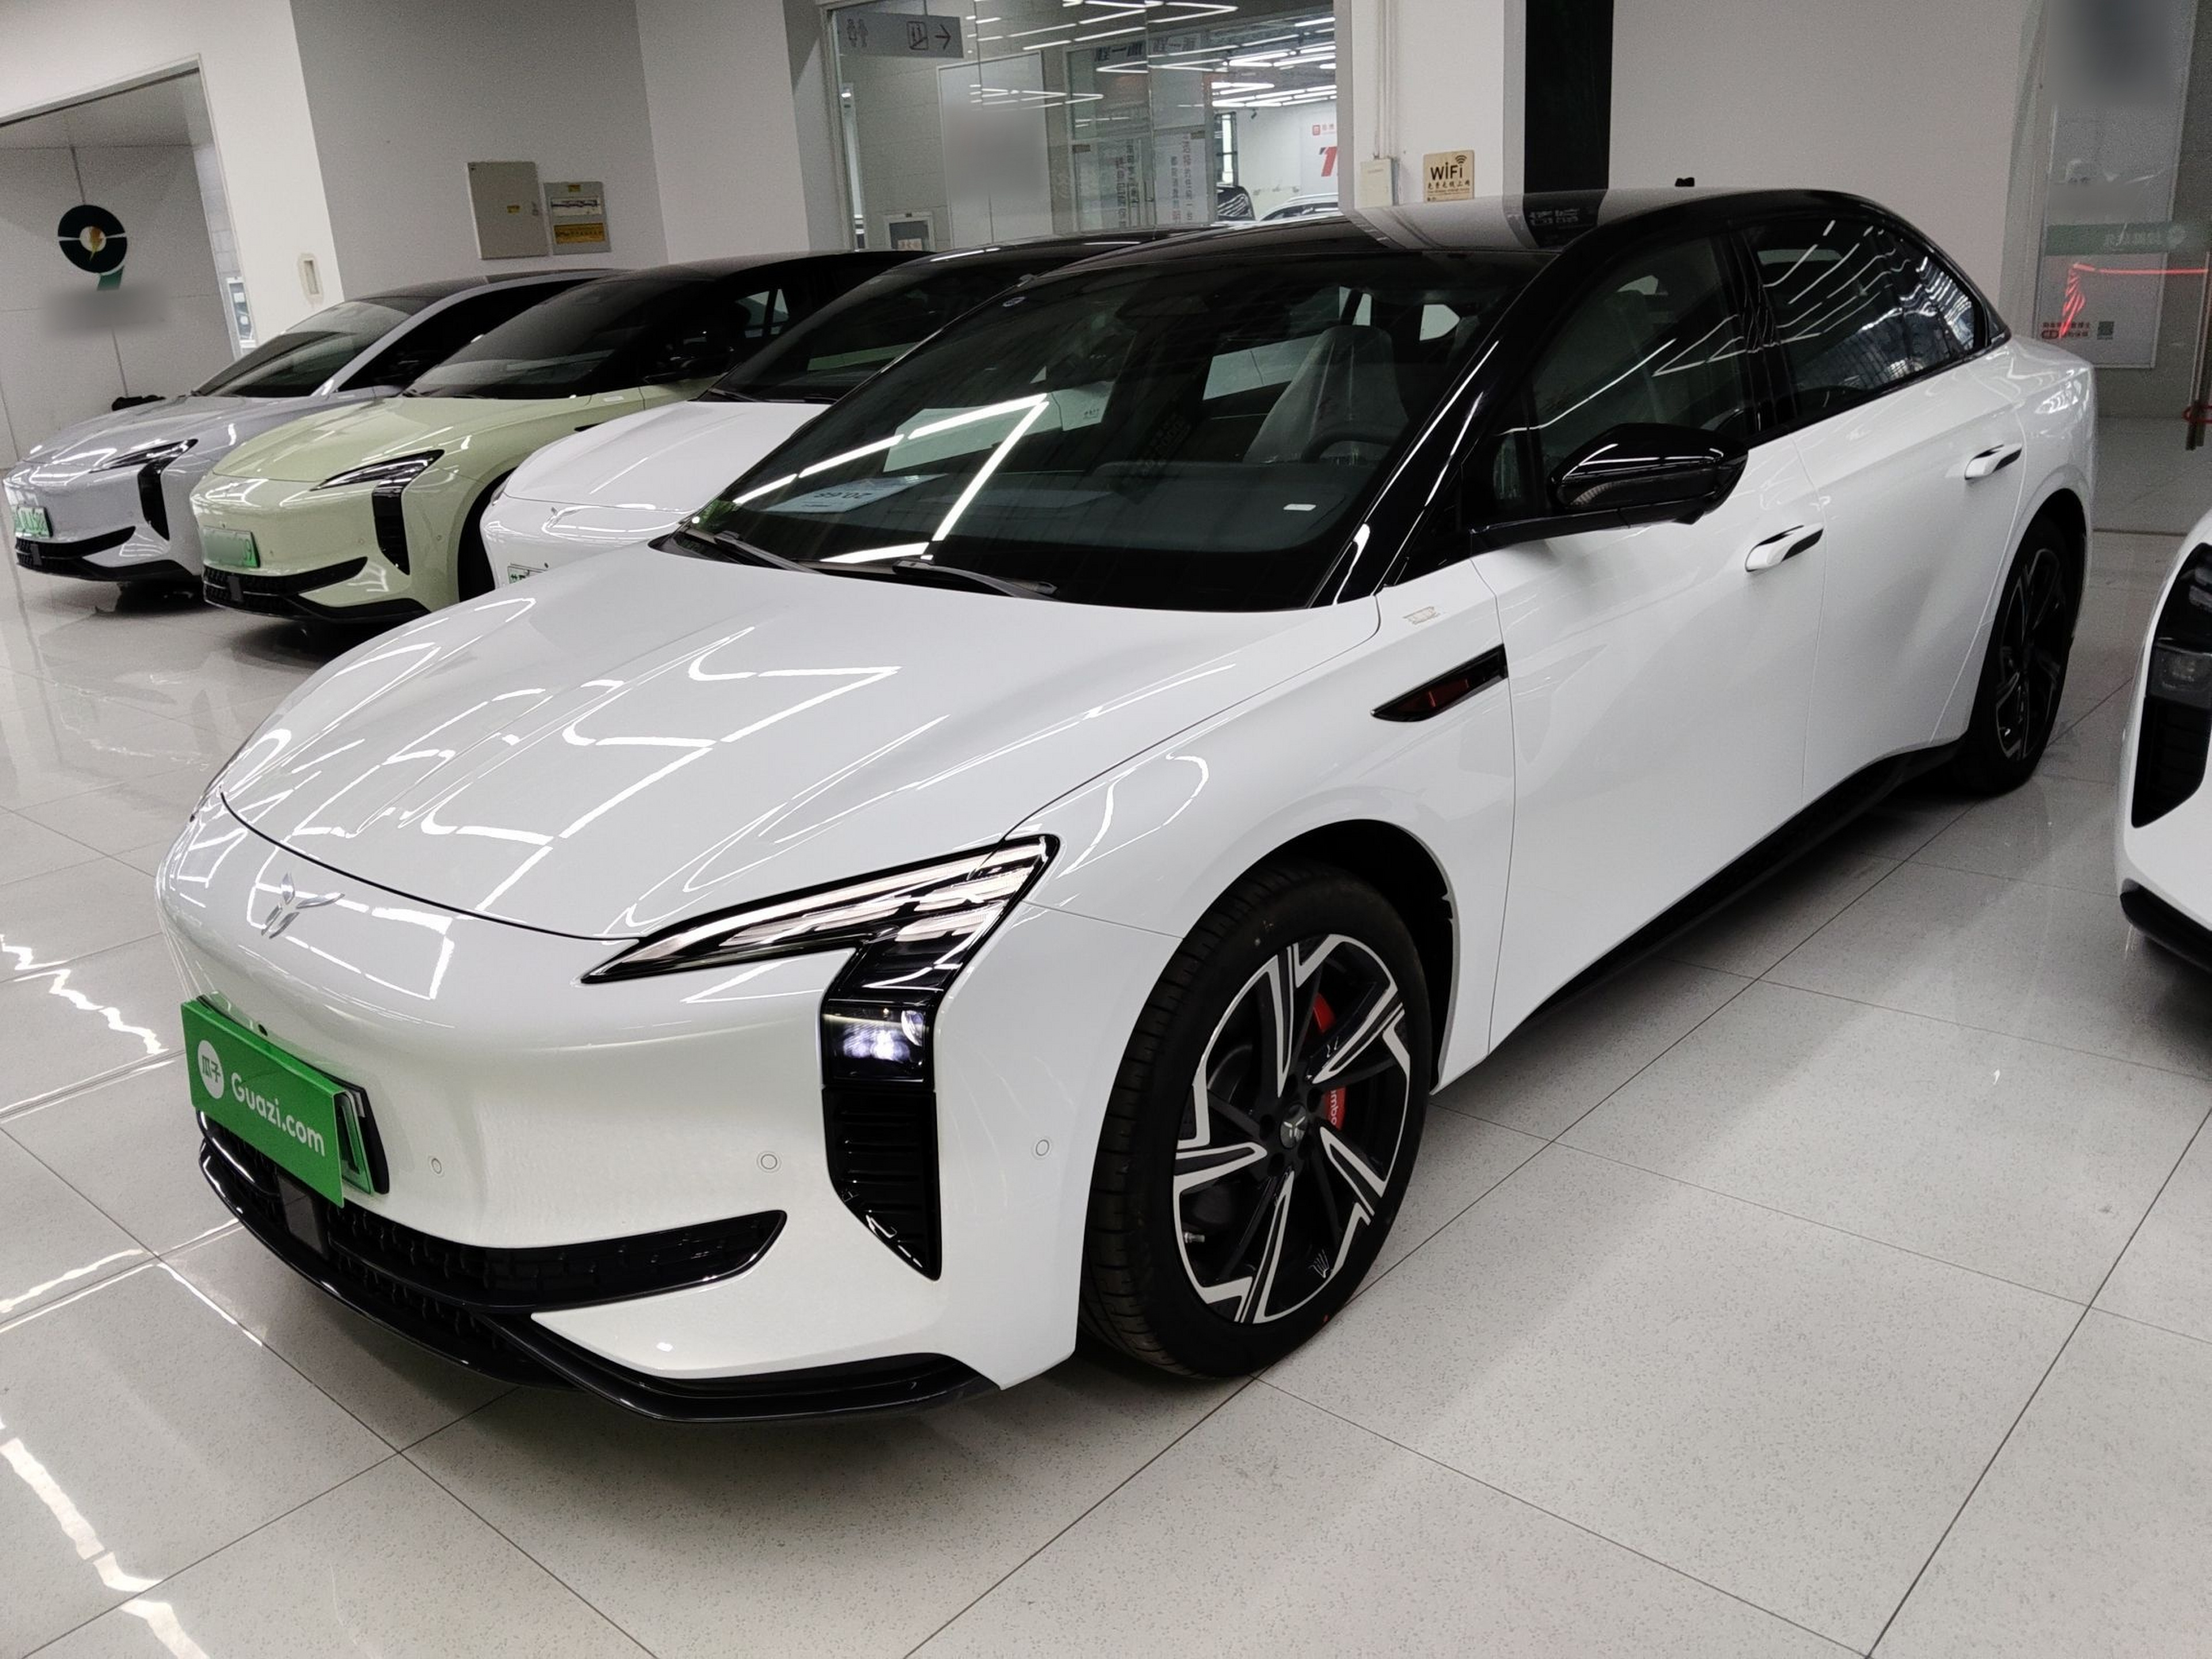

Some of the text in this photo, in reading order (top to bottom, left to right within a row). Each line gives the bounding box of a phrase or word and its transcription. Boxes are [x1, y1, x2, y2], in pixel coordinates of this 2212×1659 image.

[1430, 161, 1463, 180] WiFi
[202, 1055, 221, 1083] 瓜子
[231, 1072, 325, 1157] Guazi.com
